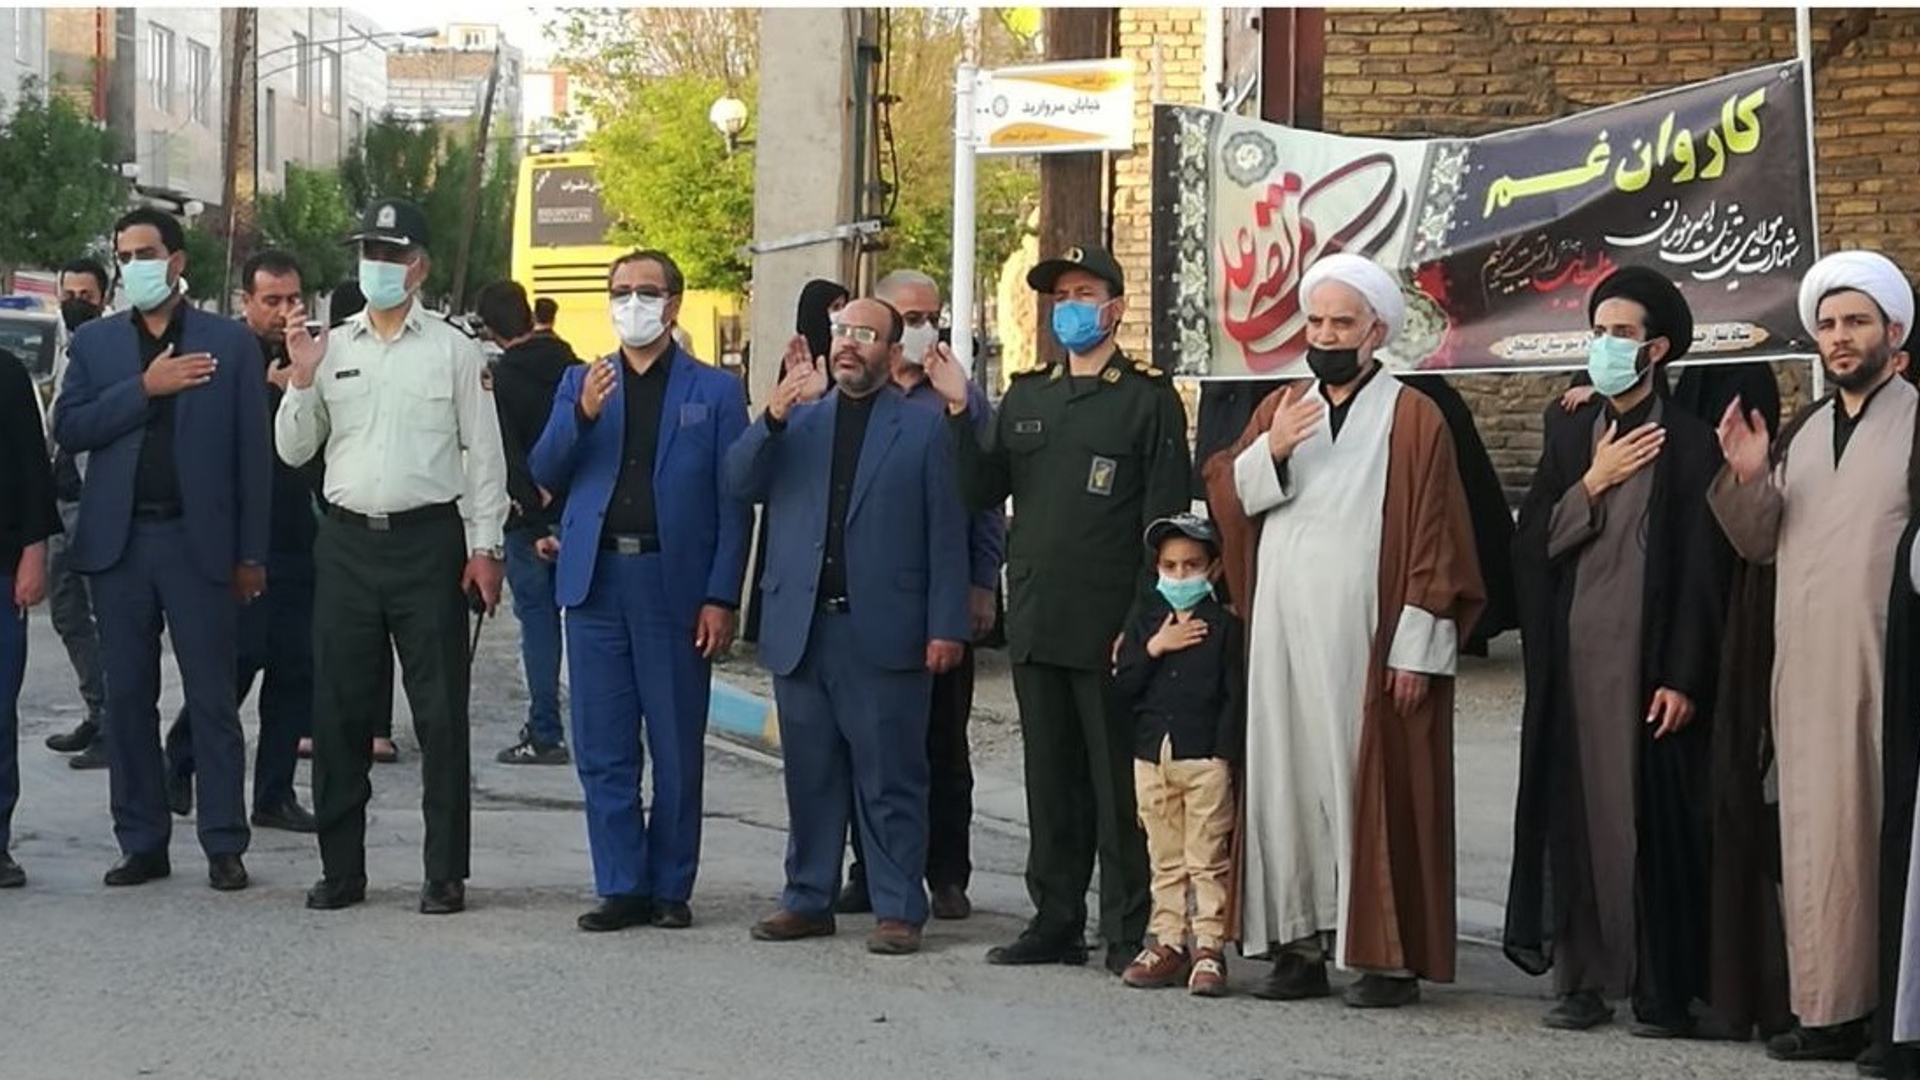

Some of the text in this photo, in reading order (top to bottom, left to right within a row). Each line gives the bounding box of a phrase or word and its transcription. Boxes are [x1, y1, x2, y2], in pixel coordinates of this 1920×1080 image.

[1022, 95, 1100, 117] خیابان مروارید
[1482, 86, 1766, 219] کاروان غم
